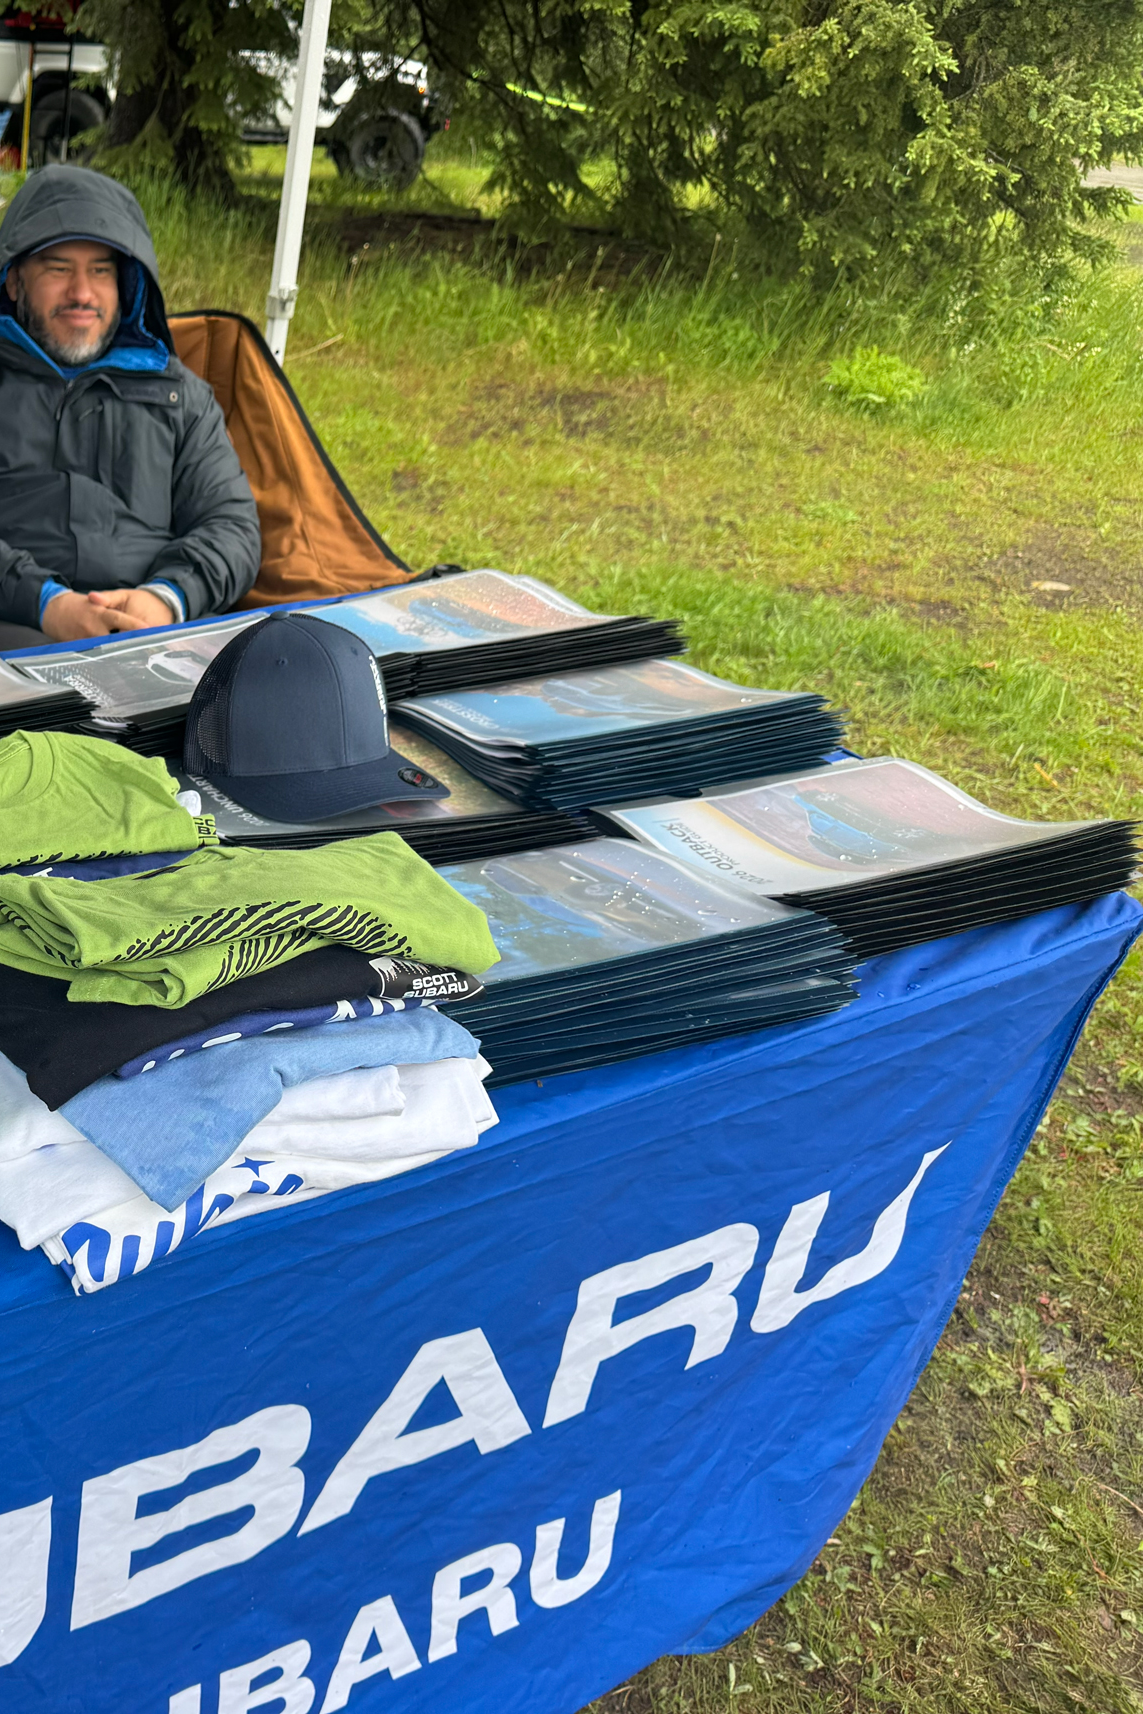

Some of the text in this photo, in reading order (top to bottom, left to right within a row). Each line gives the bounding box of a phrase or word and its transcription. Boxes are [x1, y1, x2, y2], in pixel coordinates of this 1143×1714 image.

[186, 773, 244, 813] UNCHART
[660, 822, 734, 870] OUTBACK
[401, 980, 469, 999] SUBARU
[412, 971, 458, 990] SCOTT
[169, 1489, 622, 1714] BARU
